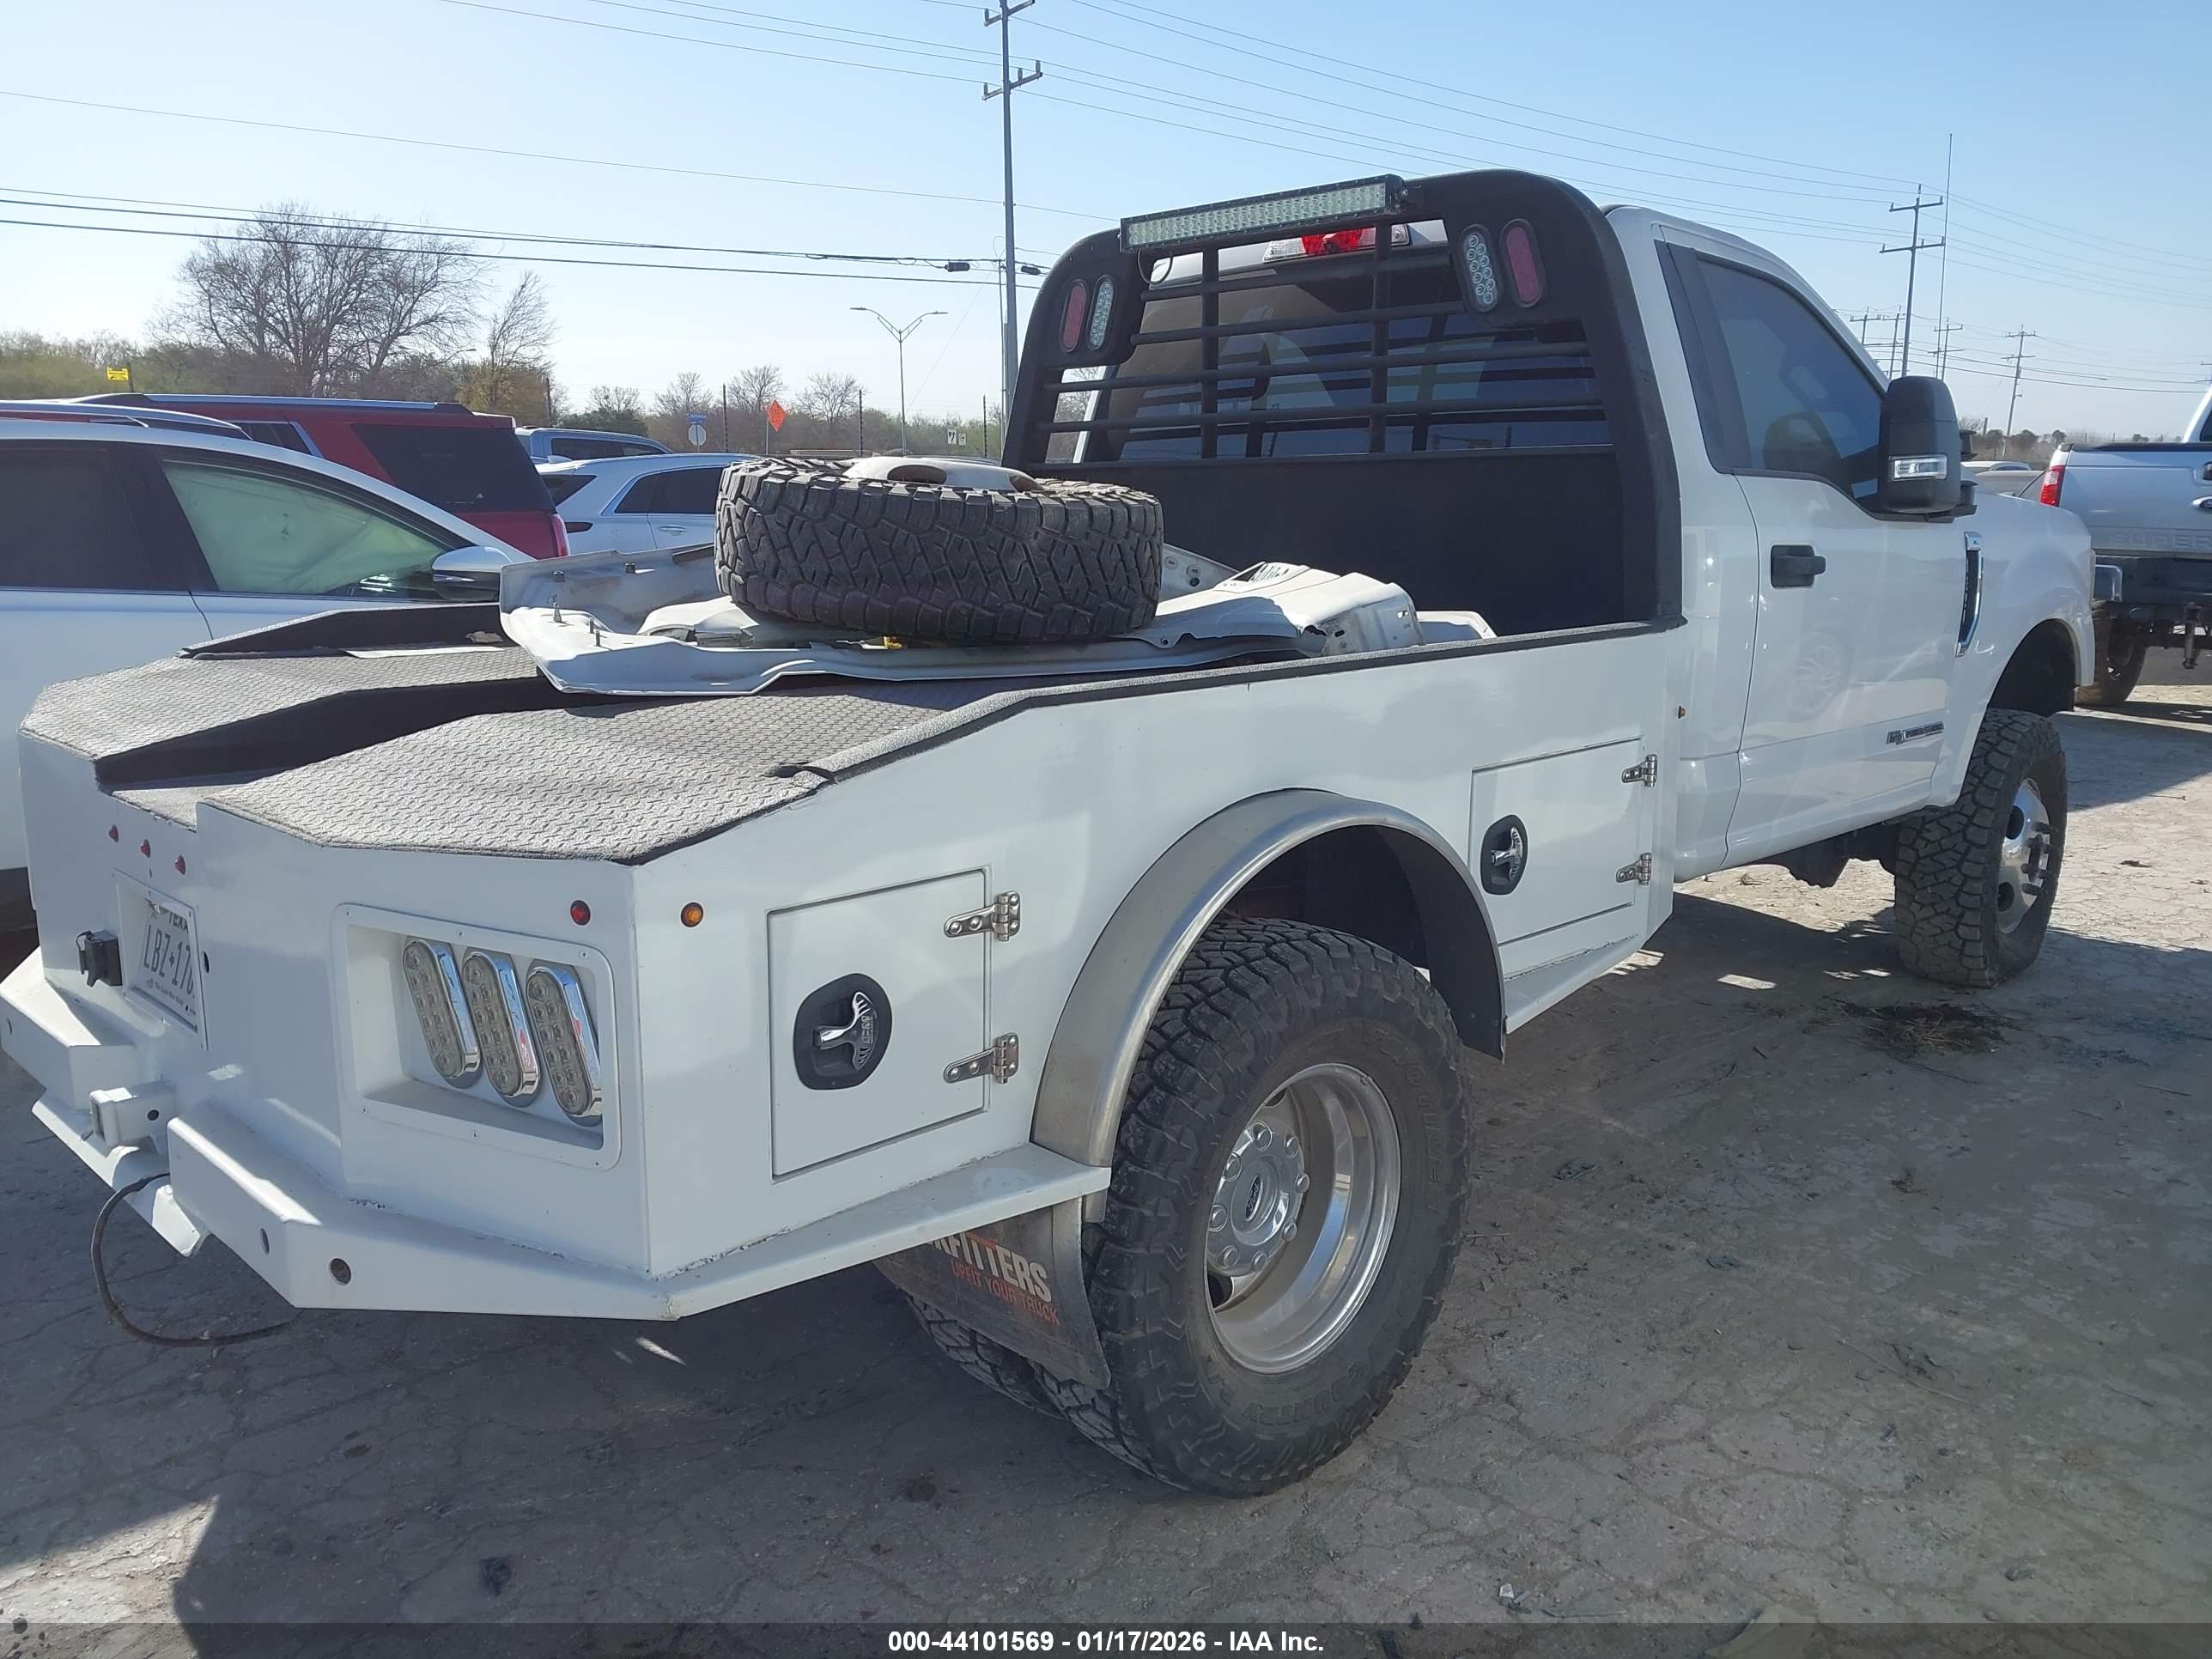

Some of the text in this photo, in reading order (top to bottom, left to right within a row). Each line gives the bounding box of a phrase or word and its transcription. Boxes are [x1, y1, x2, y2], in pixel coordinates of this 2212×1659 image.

[2109, 532, 2212, 550] SUPER
[169, 911, 188, 933] TEXA
[144, 925, 171, 978] LBZ
[951, 1259, 1060, 1326] UPFIT YOUR TRUCK
